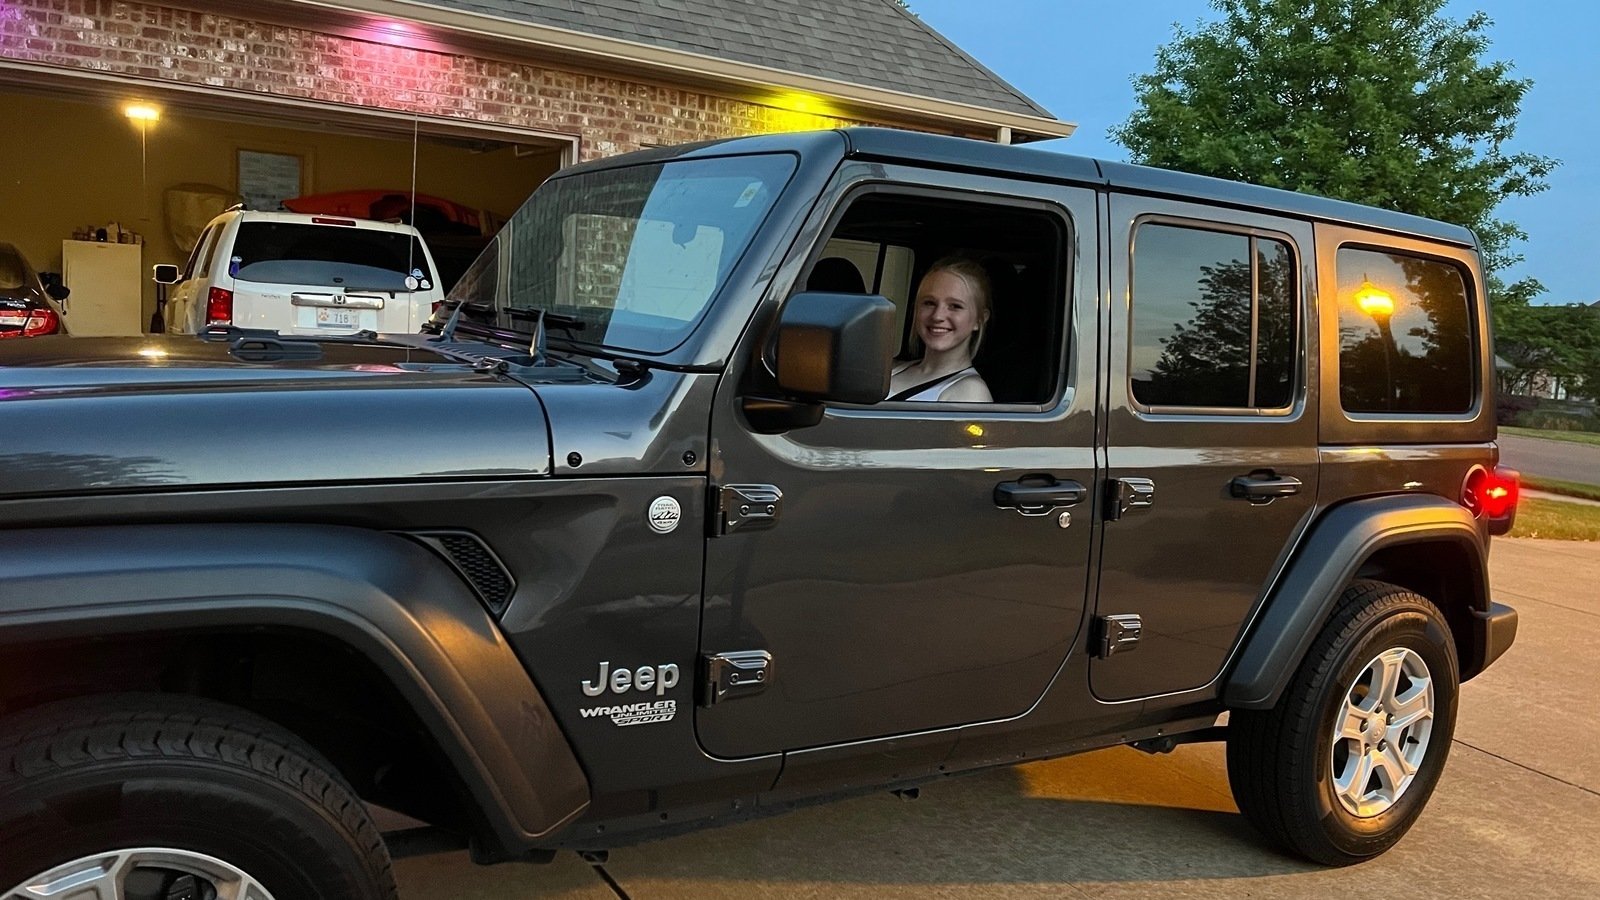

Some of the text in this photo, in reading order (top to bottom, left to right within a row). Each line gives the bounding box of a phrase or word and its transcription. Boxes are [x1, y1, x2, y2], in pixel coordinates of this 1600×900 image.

[581, 661, 680, 697] Jeep
[580, 700, 676, 718] WRANGLER
[611, 707, 677, 719] UNLIMITED
